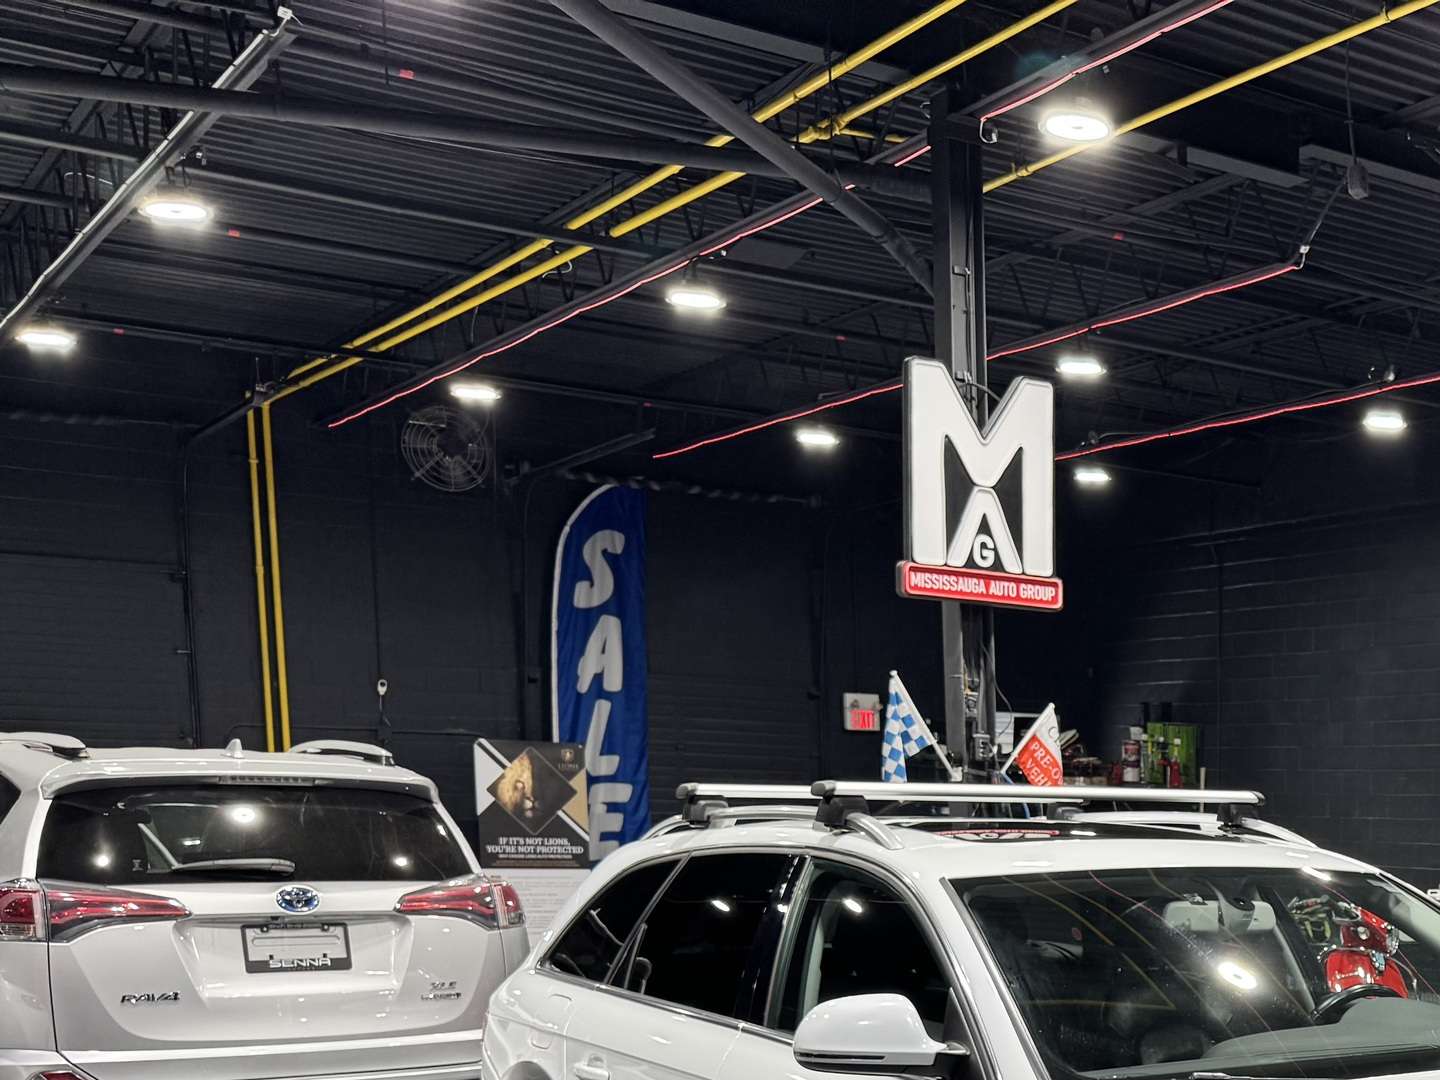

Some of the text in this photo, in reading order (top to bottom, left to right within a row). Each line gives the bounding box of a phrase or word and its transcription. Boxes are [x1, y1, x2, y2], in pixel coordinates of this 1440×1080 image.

[910, 571, 1056, 601] MISSISSAUGA AUTO GROUP
[573, 529, 634, 862] SALE
[850, 709, 875, 729] EXIT
[498, 836, 571, 847] IF IT'S NOT LIONS,
[486, 845, 584, 855] YOU'RE NOT PROTECTED
[269, 958, 332, 969] SENNA
[120, 991, 180, 1004] RAV4
